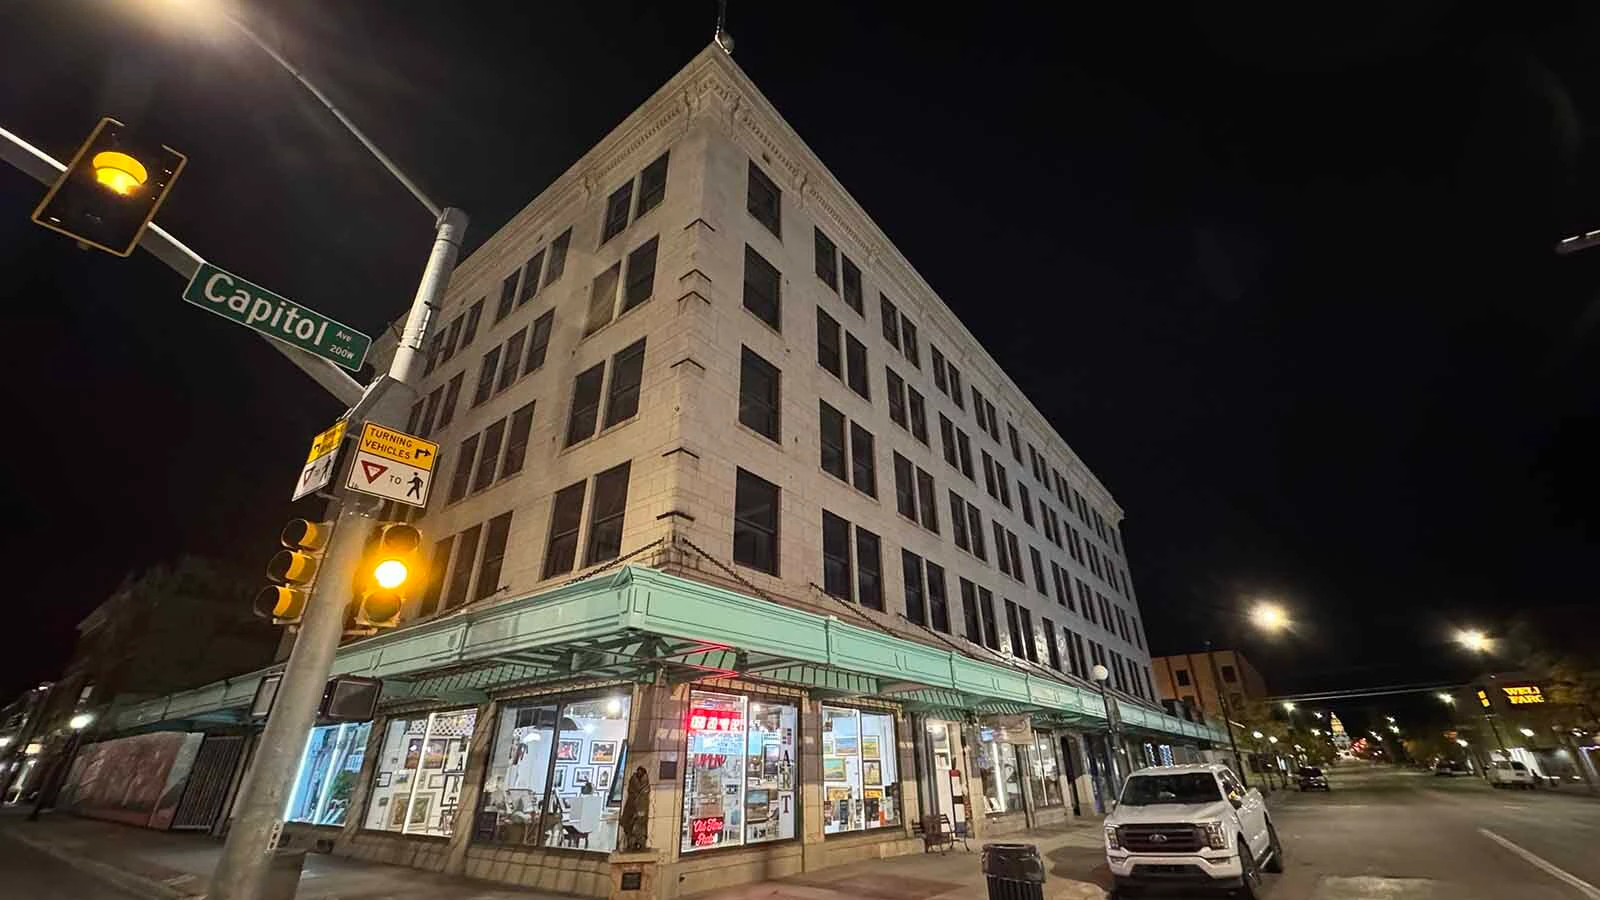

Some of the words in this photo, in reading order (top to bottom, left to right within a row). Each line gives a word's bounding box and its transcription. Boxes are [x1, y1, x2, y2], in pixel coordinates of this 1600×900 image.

[204, 272, 328, 346] Capitol
[335, 330, 352, 342] Ave
[329, 344, 355, 360] 200W
[369, 427, 413, 448] TURNING
[365, 439, 410, 460] VEHICLES
[389, 474, 402, 485] TO
